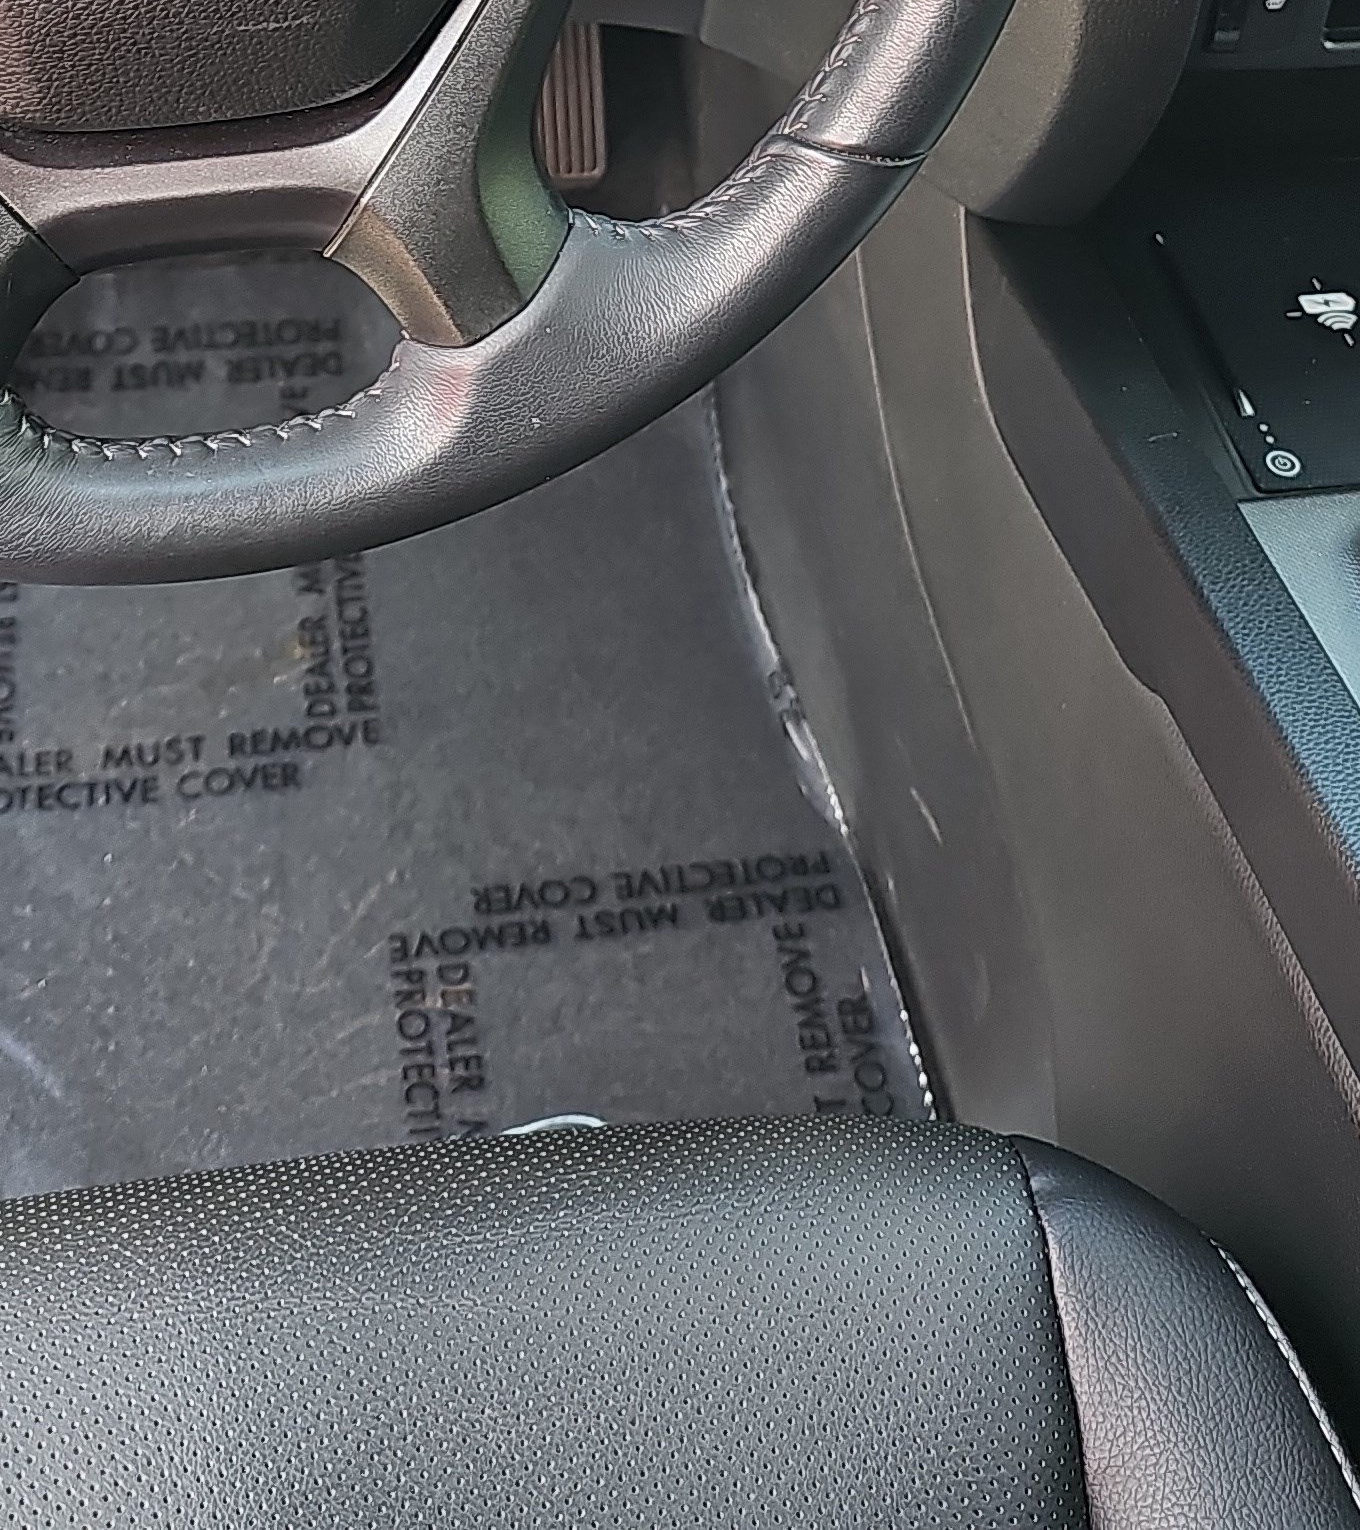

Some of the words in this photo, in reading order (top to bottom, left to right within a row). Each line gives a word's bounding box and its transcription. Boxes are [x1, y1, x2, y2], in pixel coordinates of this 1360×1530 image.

[149, 318, 342, 355] PROTECTIVE
[110, 361, 206, 393] MUST
[227, 351, 344, 385] DEALER
[297, 616, 337, 718] DEALER
[101, 734, 207, 770] MUST
[228, 719, 381, 758] REMOVE
[176, 762, 303, 802] COVER
[473, 875, 598, 915] COVER
[616, 851, 832, 902] PROTECTIVE
[573, 902, 678, 942] MUST
[707, 883, 847, 925] DEALER
[389, 920, 552, 963] REMOVE
[773, 922, 838, 1076] REMOVE
[436, 962, 485, 1095] DEALER
[389, 967, 441, 1136] PROTECTI
[836, 989, 897, 1118] COVER
